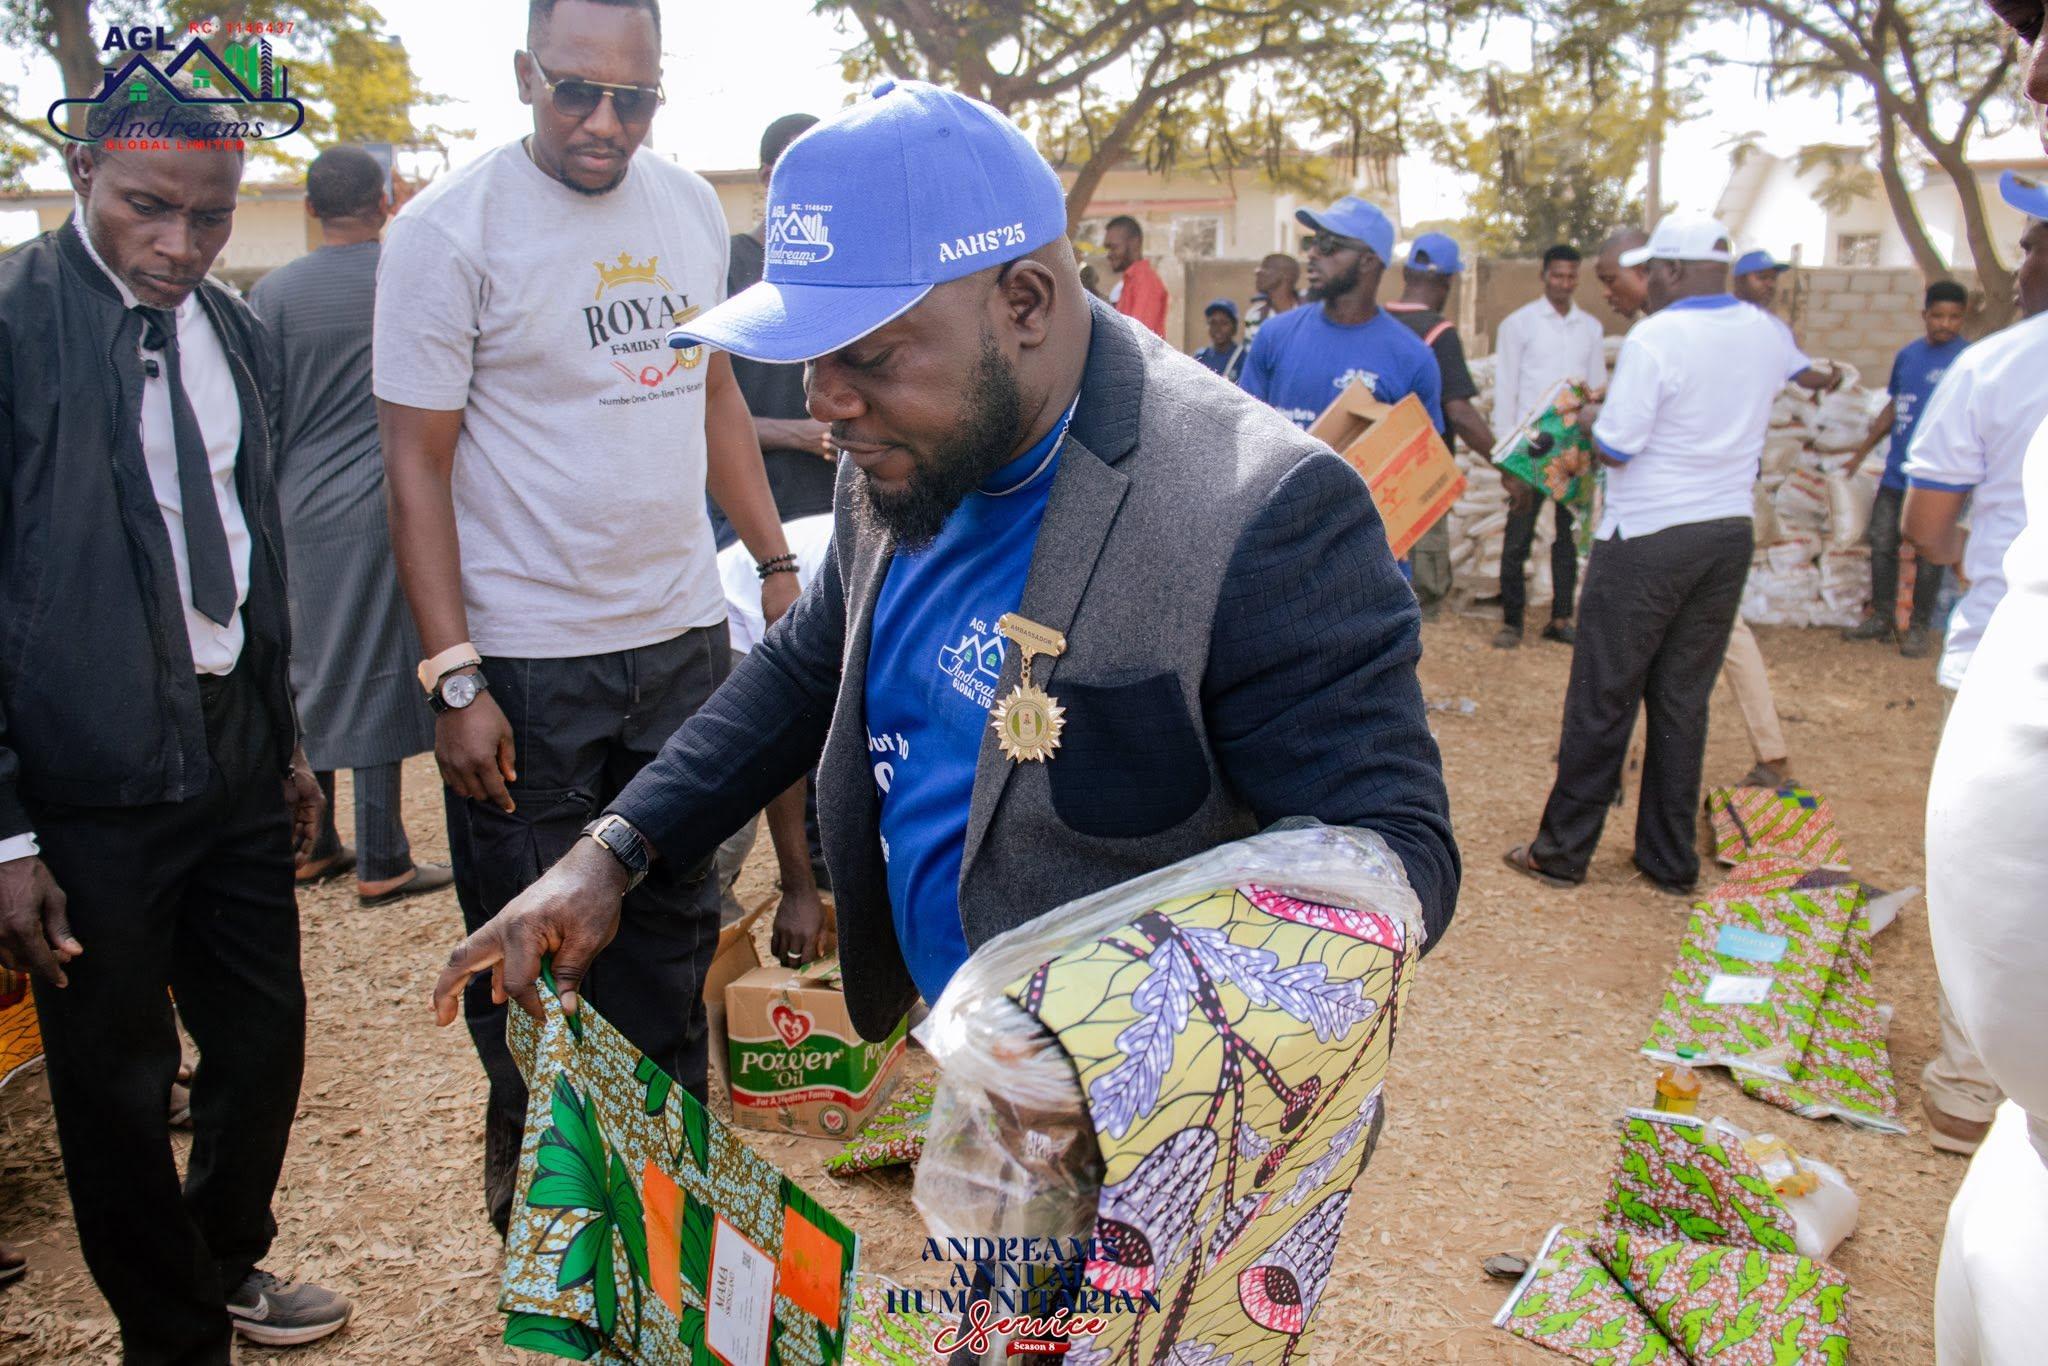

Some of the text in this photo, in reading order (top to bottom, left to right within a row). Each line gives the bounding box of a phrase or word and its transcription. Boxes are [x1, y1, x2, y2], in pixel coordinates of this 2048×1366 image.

[939, 222, 1026, 264] AAHS'25
[610, 339, 661, 355] FAMILY
[969, 617, 988, 636] AGL
[1010, 624, 1053, 646] AMBASSADOR
[952, 677, 993, 709] GLOBAL LTD
[740, 1050, 840, 1074] Power
[777, 1070, 805, 1087] Oil
[808, 1090, 836, 1100] Family
